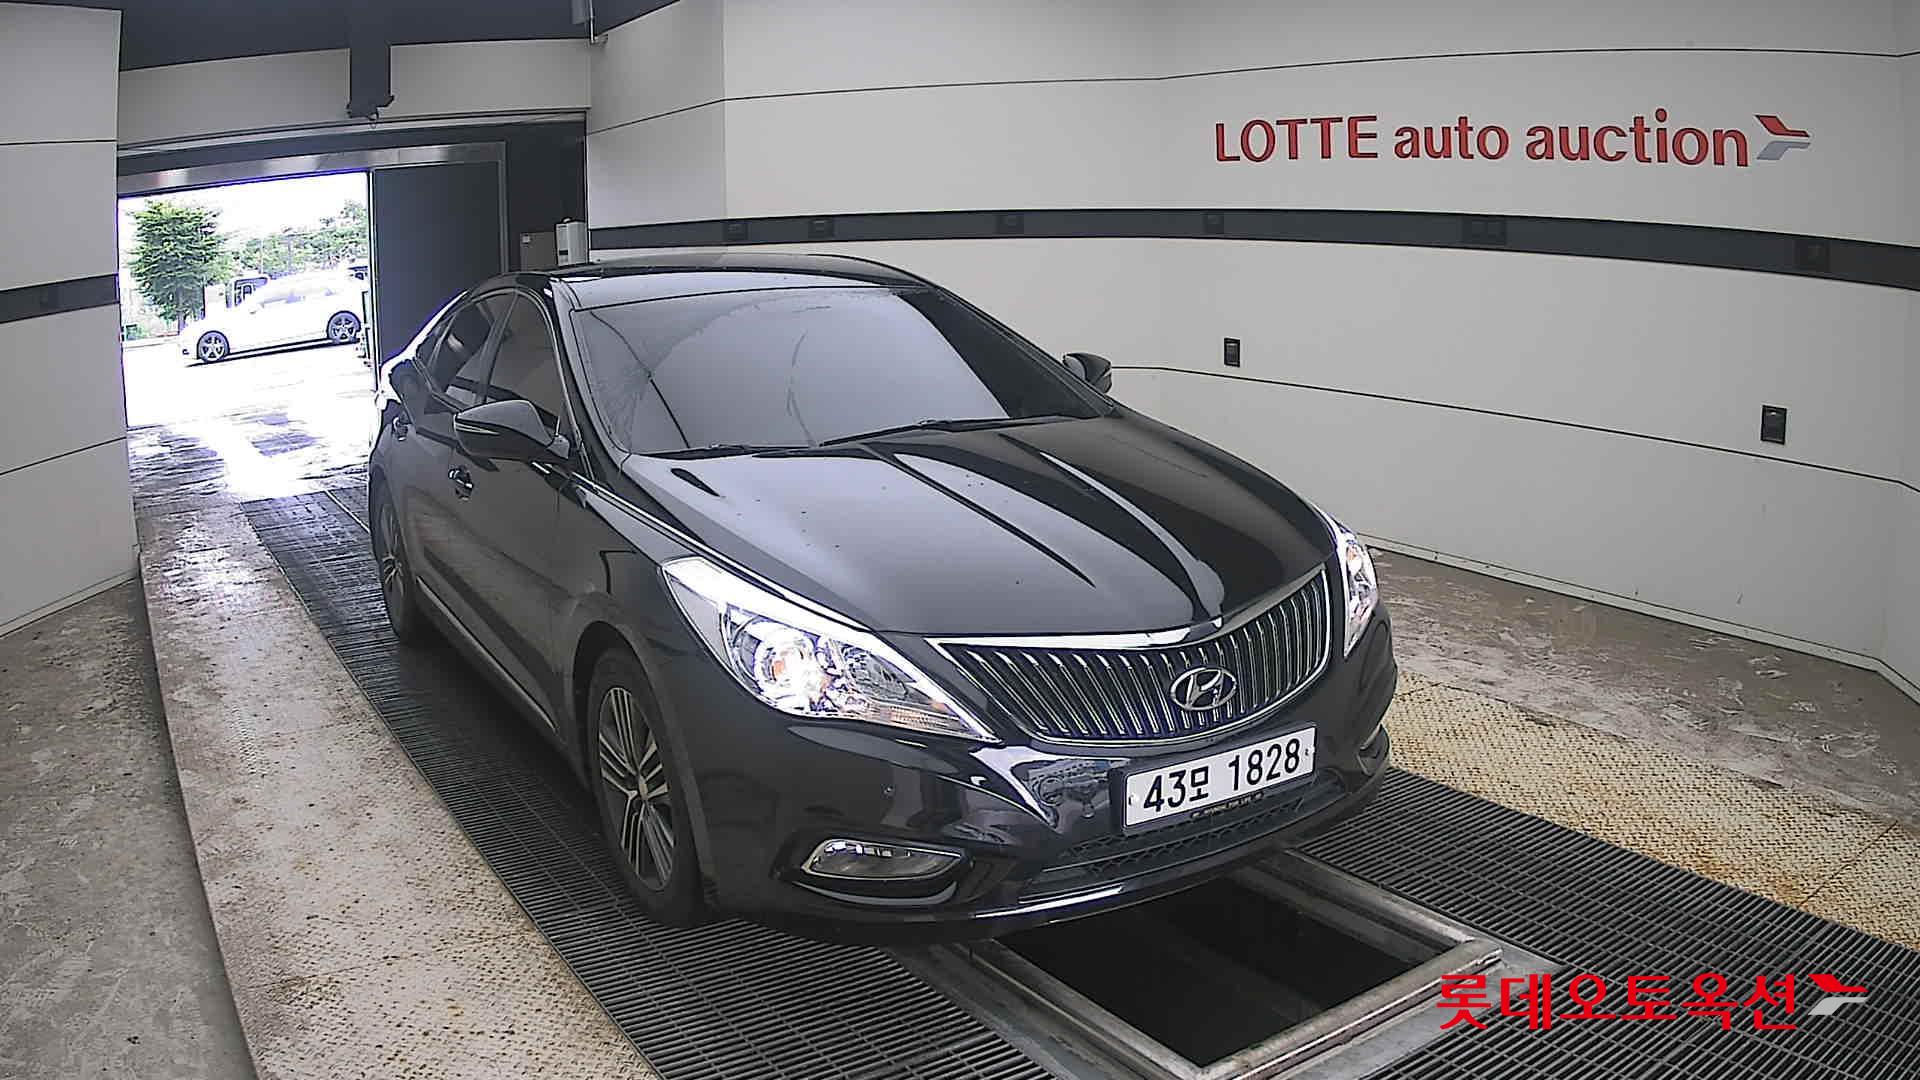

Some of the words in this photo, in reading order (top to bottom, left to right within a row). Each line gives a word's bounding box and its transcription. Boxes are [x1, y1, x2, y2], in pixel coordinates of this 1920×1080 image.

[1215, 115, 1378, 162] LOTTE
[1393, 116, 1510, 161] auto
[1525, 108, 1749, 167] auction
[1143, 766, 1209, 812] 43모
[1228, 738, 1301, 791] 1828
